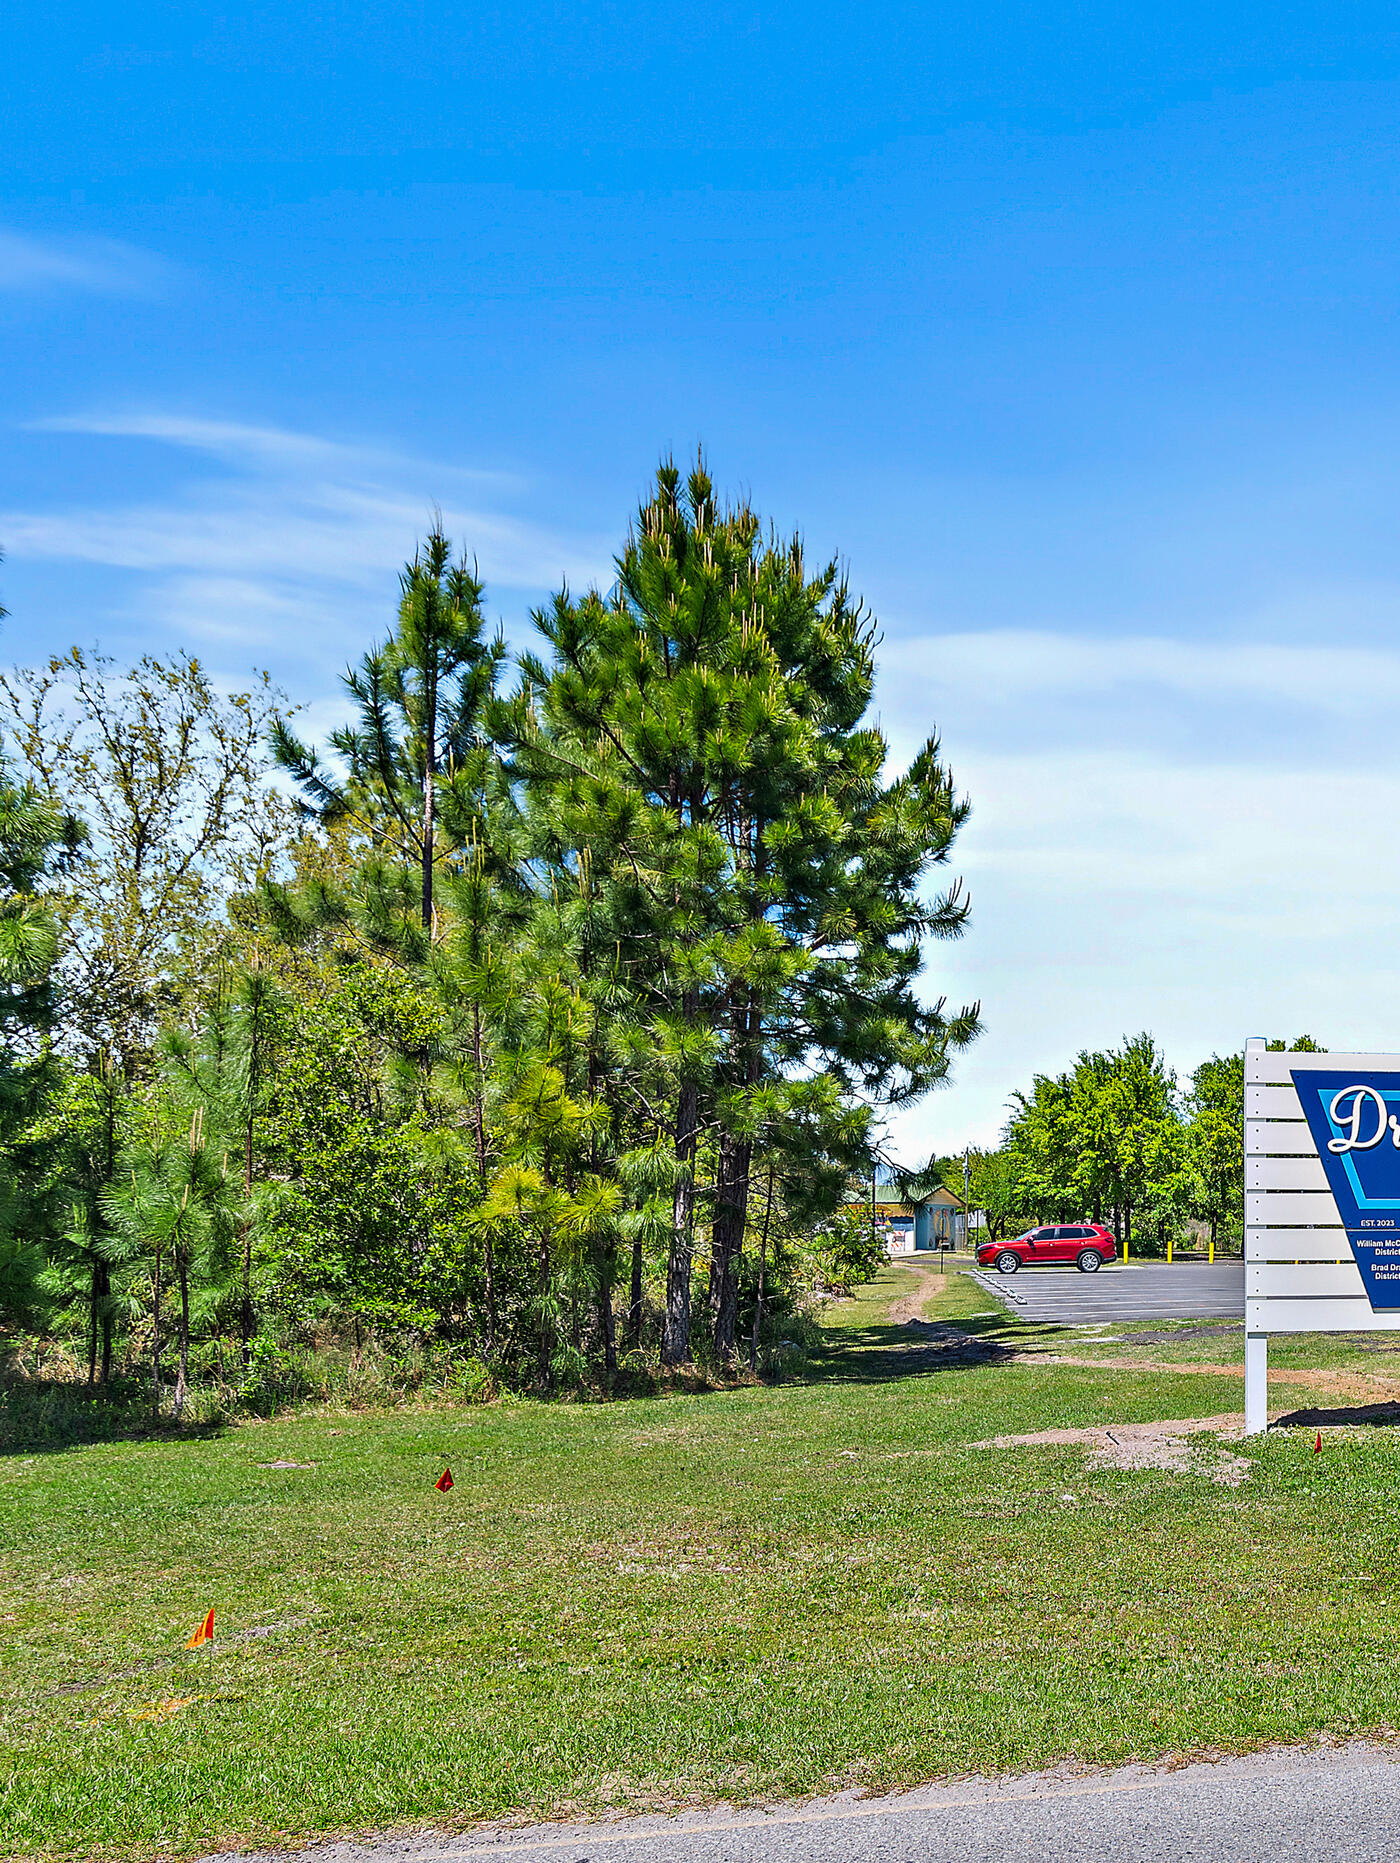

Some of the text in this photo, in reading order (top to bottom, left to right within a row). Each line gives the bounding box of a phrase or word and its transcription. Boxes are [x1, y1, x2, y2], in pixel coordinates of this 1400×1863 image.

[1360, 1219, 1395, 1227] EST. 2023
[1356, 1239, 1384, 1248] William
[1371, 1263, 1390, 1271] Brad
